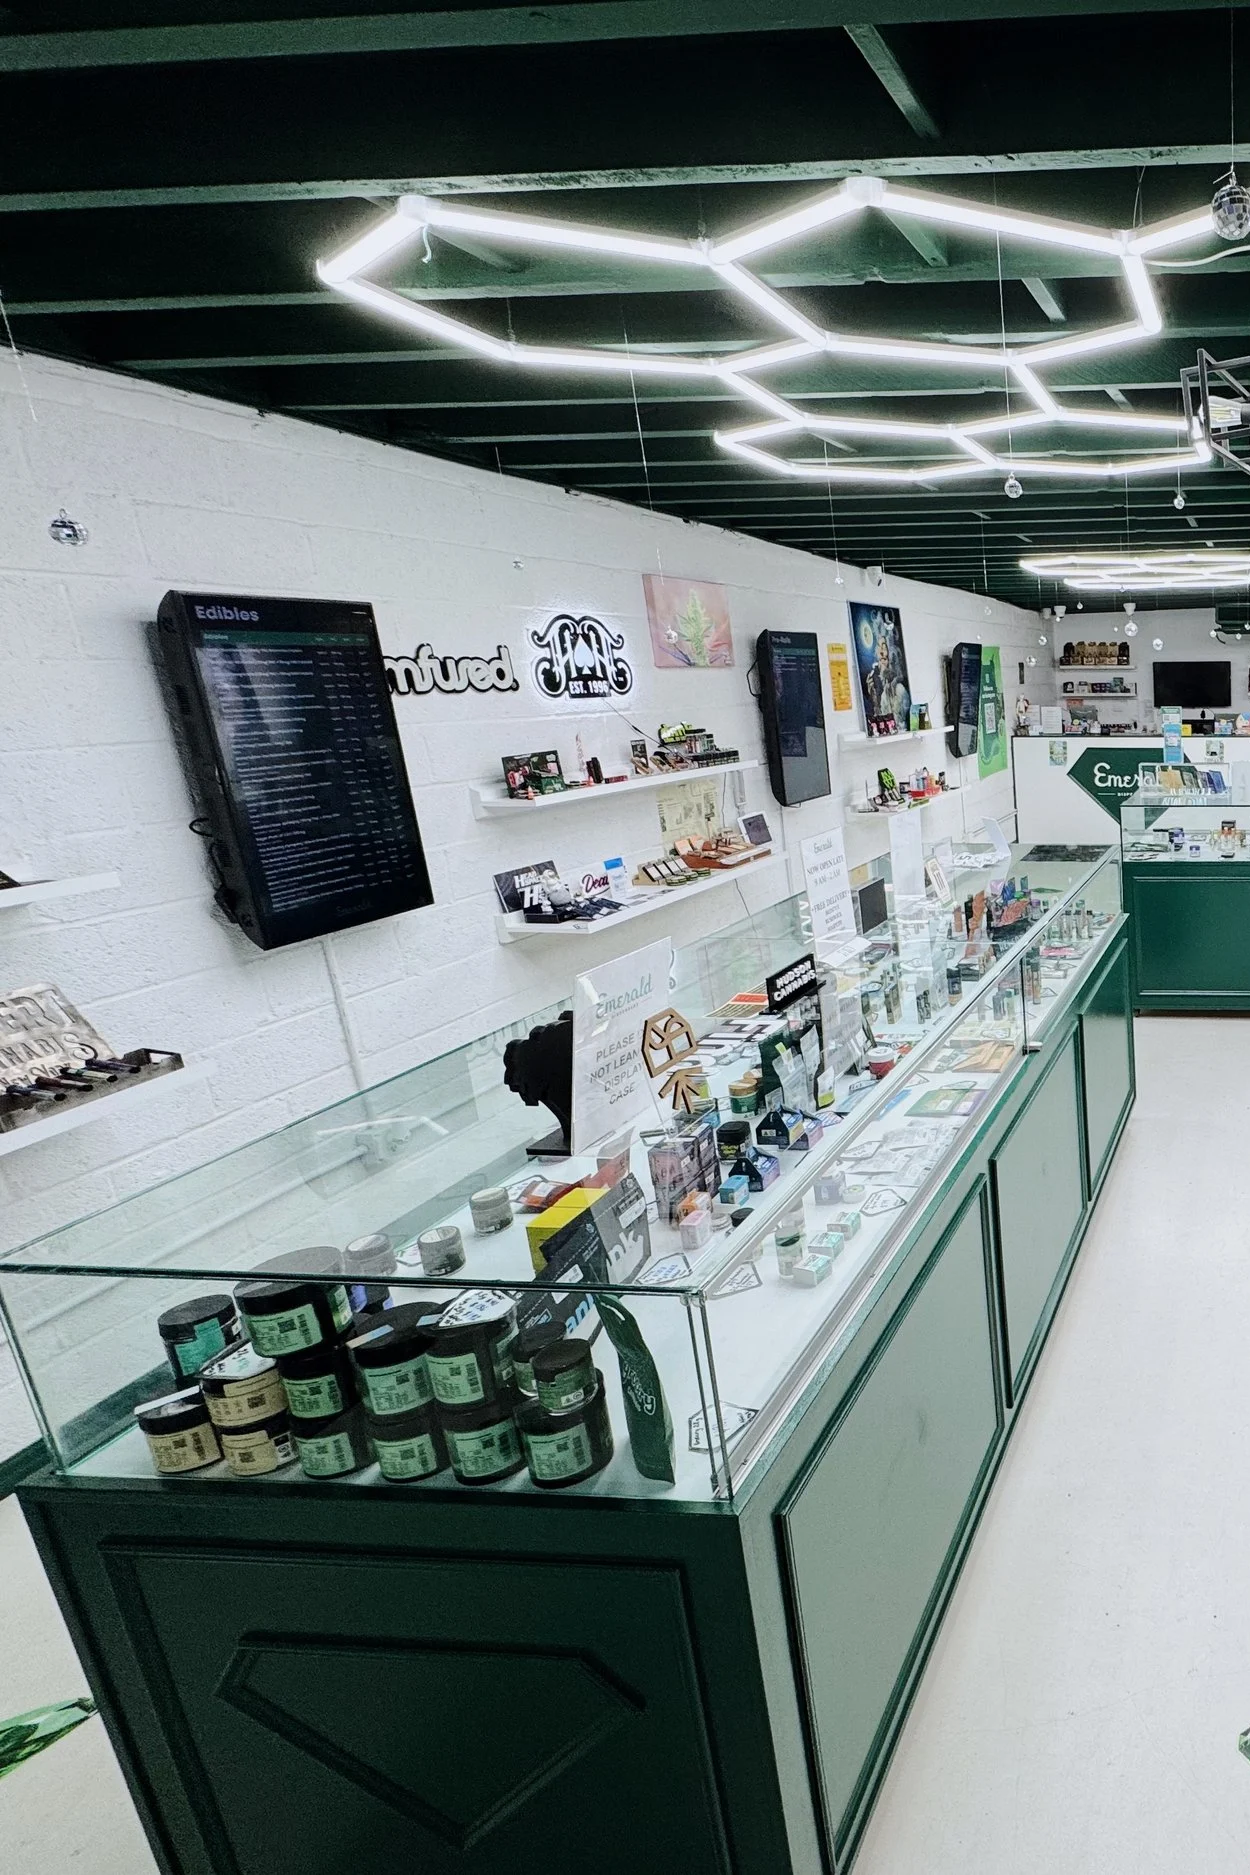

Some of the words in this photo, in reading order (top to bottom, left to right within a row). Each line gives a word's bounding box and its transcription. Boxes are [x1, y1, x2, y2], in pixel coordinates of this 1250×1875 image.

[194, 605, 260, 622] Edibles
[568, 680, 587, 695] EST.
[588, 680, 610, 693] 1996
[776, 960, 812, 989] HUDSON
[595, 973, 654, 1019] Emerald
[596, 1030, 637, 1062] PLEASE
[590, 1063, 613, 1083] NOT
[613, 1048, 641, 1070] LEAN
[604, 1062, 643, 1092] DISPLAY
[609, 1081, 637, 1105] CASE
